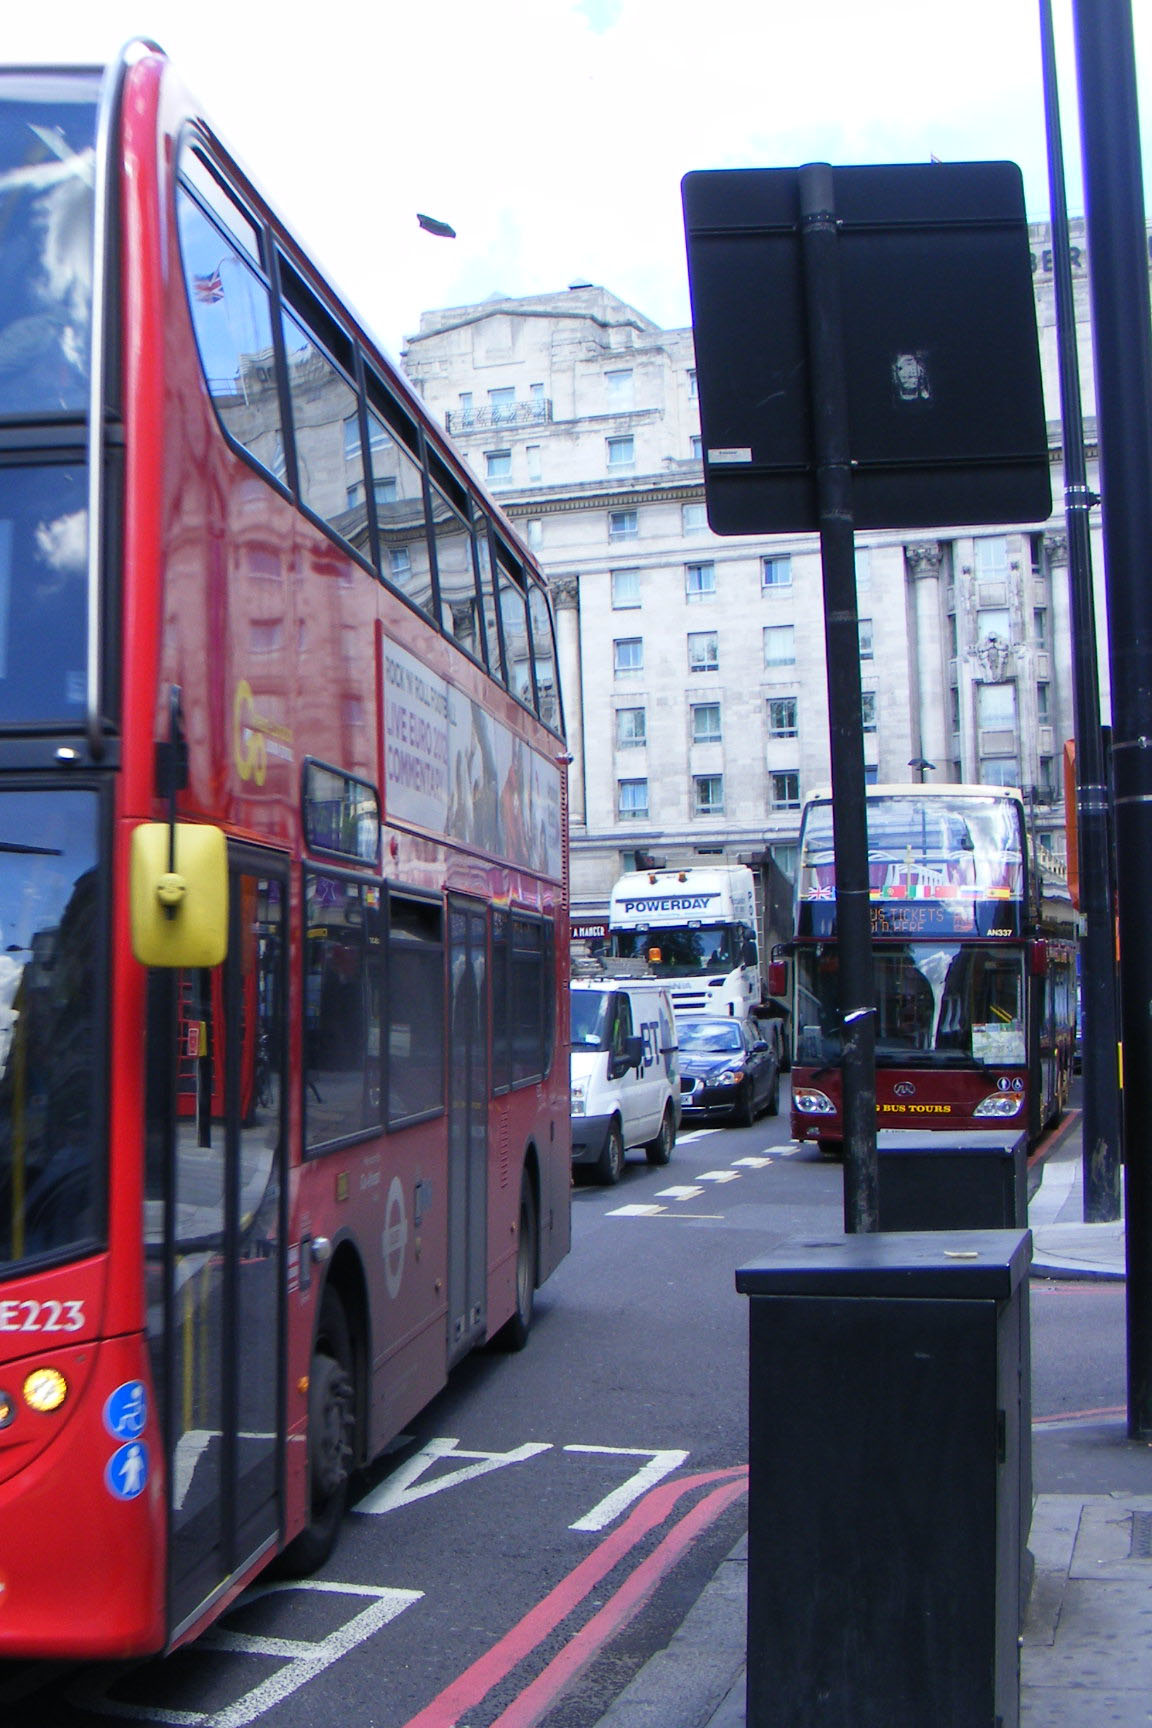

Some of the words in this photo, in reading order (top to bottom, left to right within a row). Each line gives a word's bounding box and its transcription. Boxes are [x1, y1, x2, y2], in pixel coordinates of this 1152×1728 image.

[625, 899, 710, 913] POWERDAY
[890, 908, 944, 922] TICKETS
[573, 928, 579, 937] A
[987, 929, 1013, 937] AN337
[883, 1104, 906, 1112] BUS
[909, 1105, 951, 1113] TOURS
